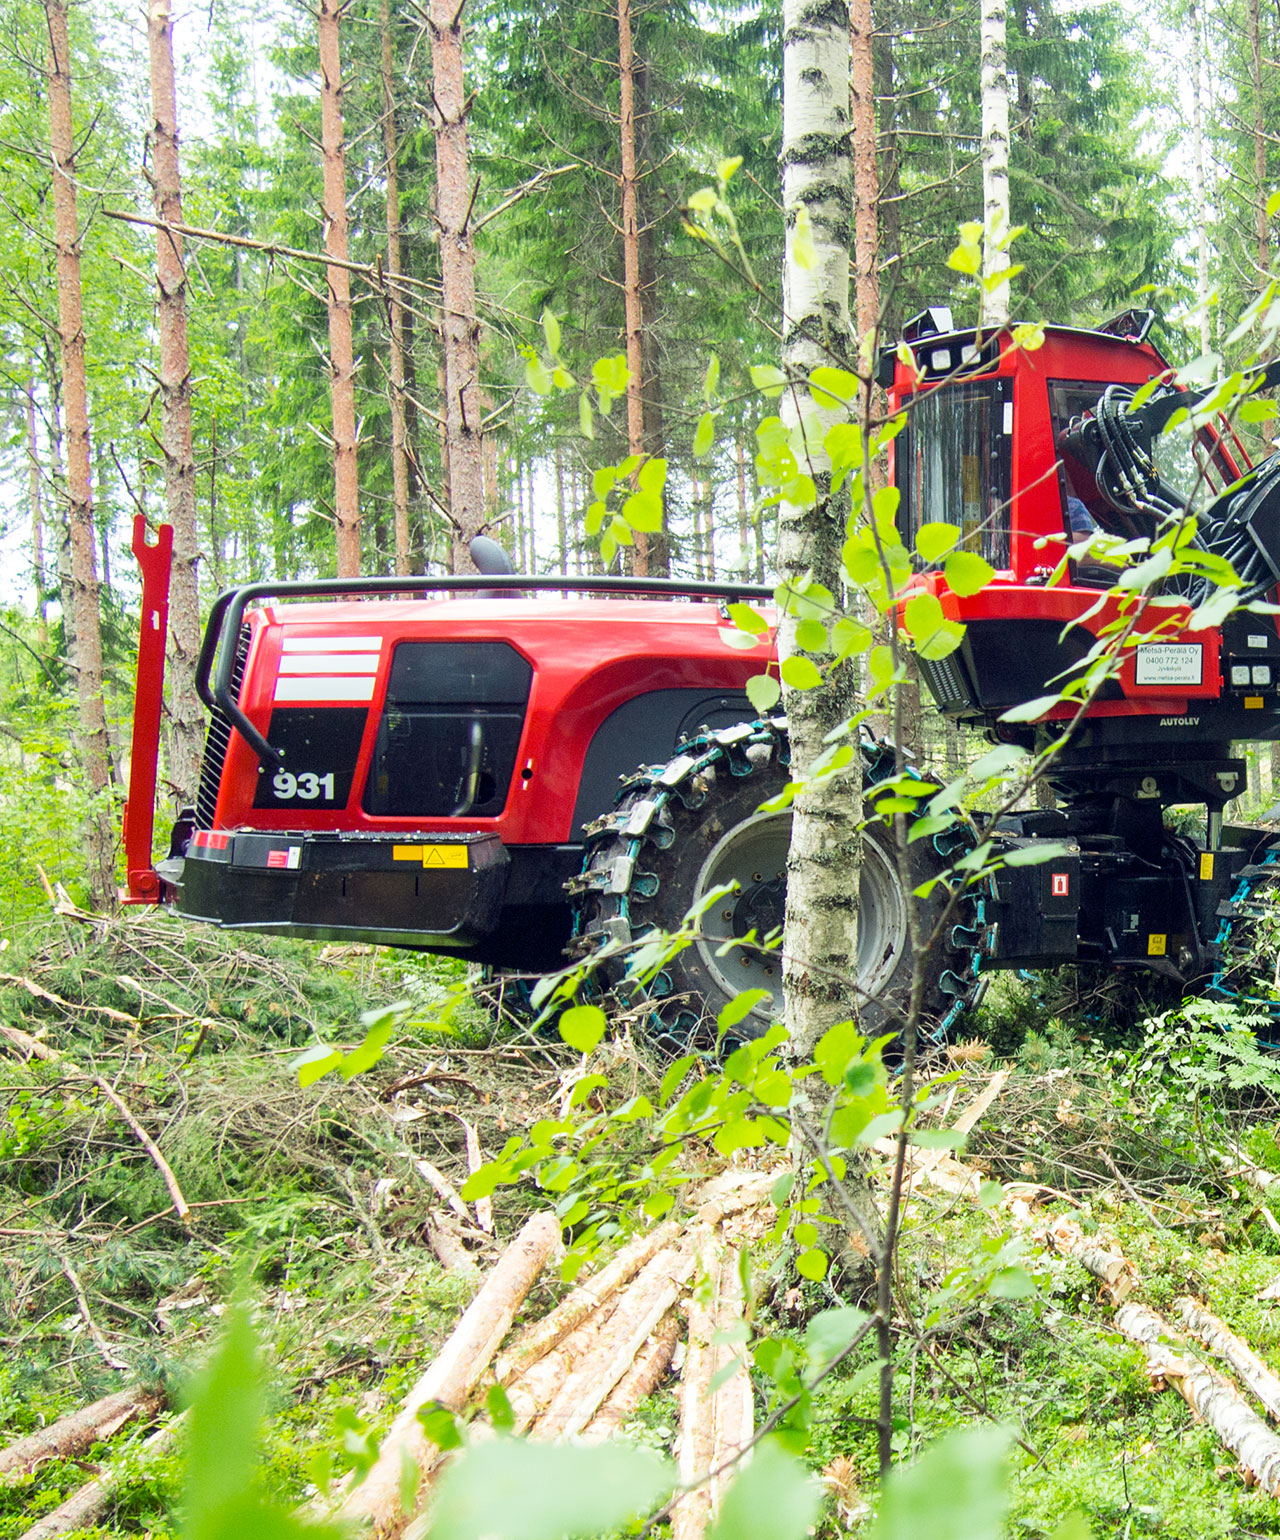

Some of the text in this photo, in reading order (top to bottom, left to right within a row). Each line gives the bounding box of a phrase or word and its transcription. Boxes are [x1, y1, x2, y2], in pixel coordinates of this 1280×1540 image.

[1188, 647, 1199, 655] Oy
[1166, 656, 1179, 664] 772
[1181, 656, 1193, 664] 124
[1160, 717, 1200, 726] AUTOLEV
[272, 772, 335, 801] 931
